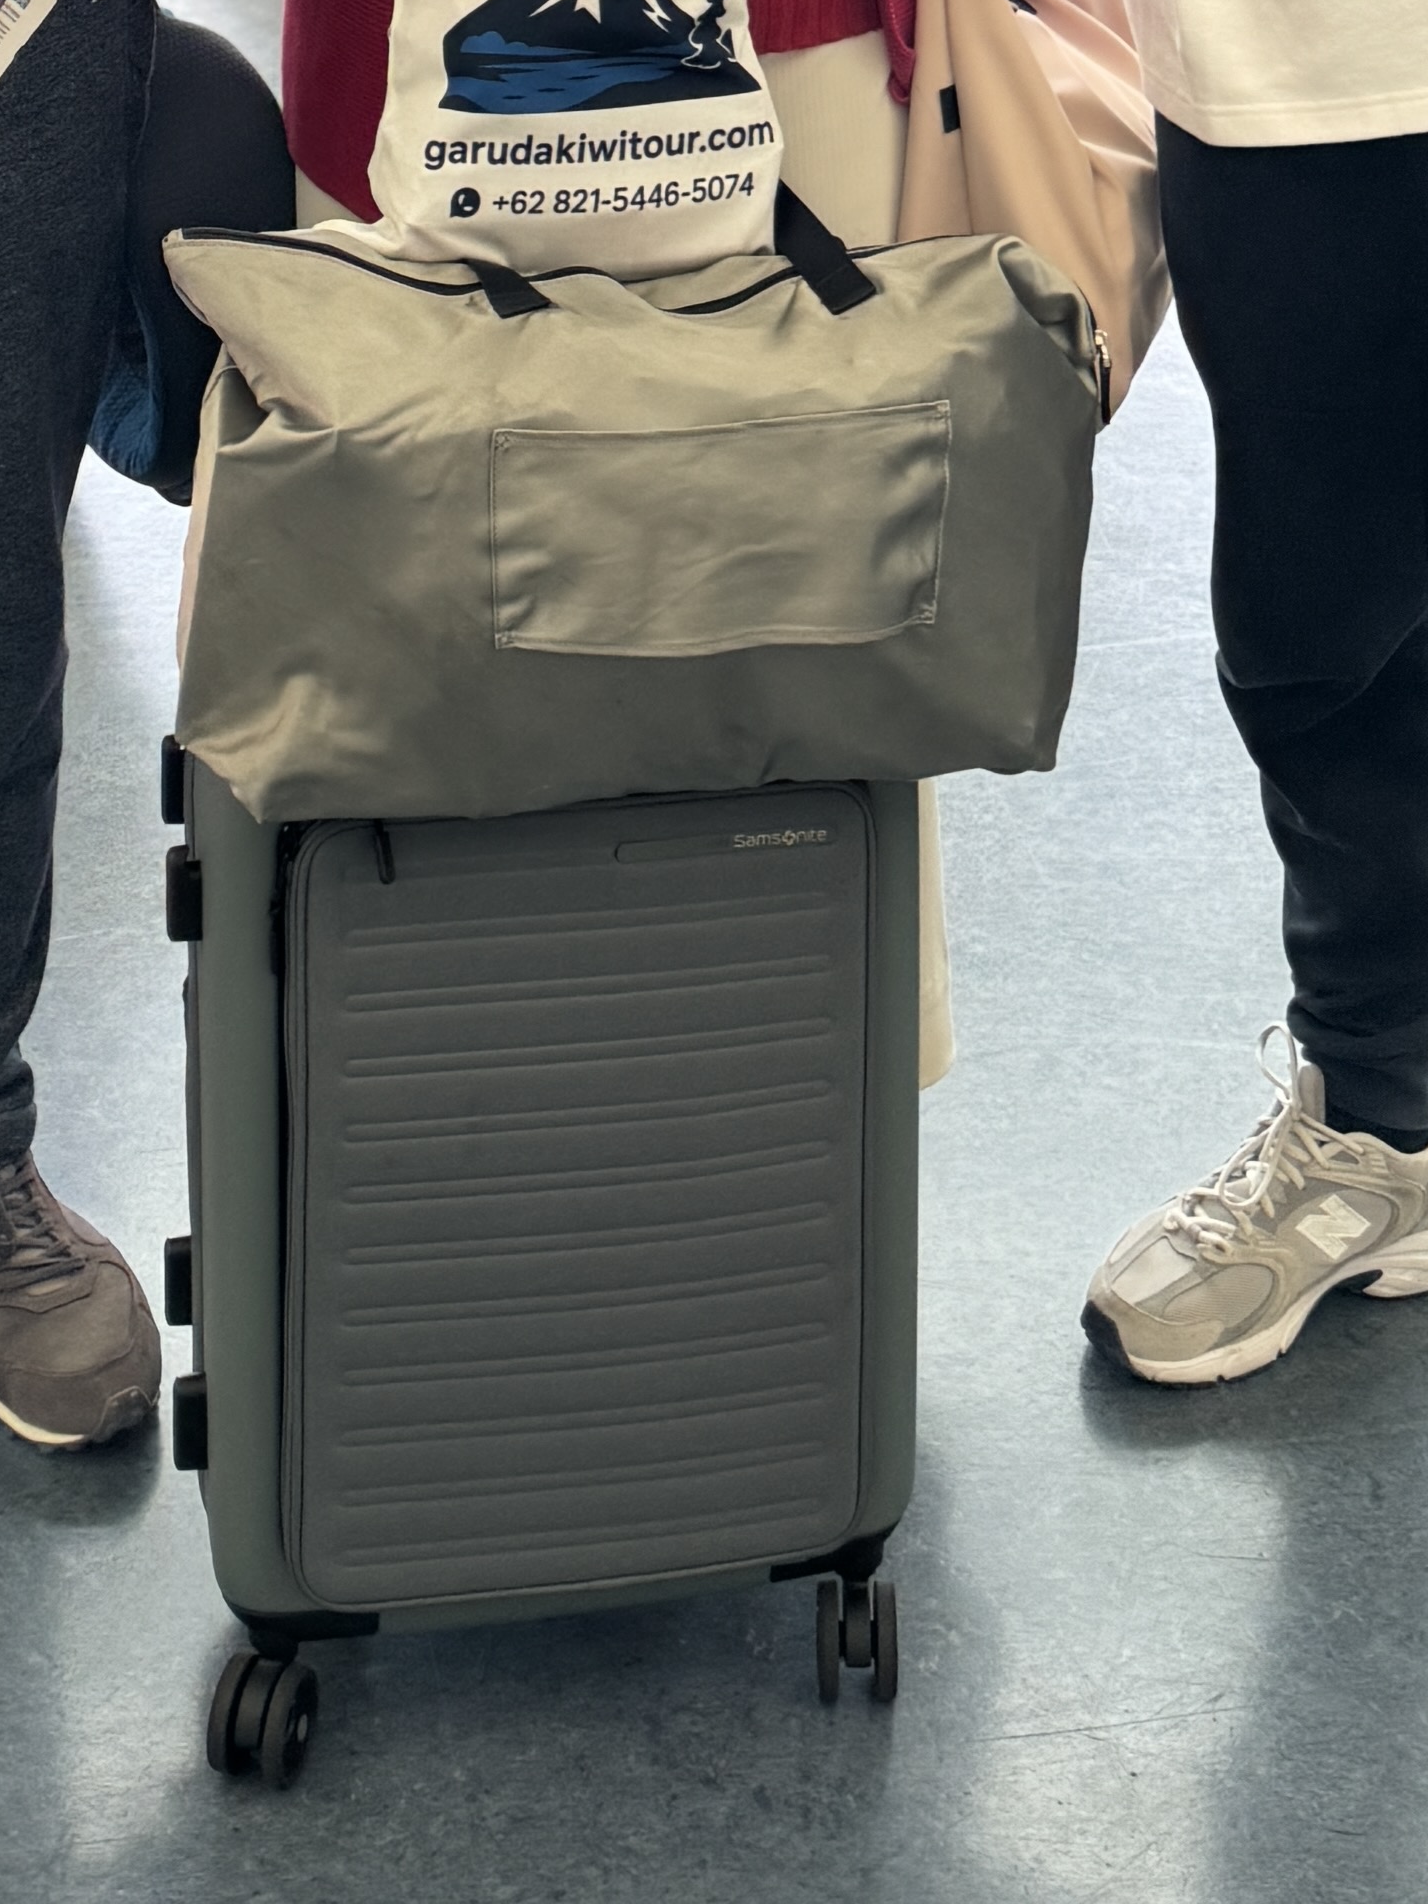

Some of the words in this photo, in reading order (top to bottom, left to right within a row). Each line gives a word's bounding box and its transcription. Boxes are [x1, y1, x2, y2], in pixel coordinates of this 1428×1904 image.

[424, 121, 775, 171] garudakiwitour.com
[493, 190, 545, 215] +62
[553, 172, 755, 215] 821-5446-5074
[733, 829, 828, 848] Samsonite
